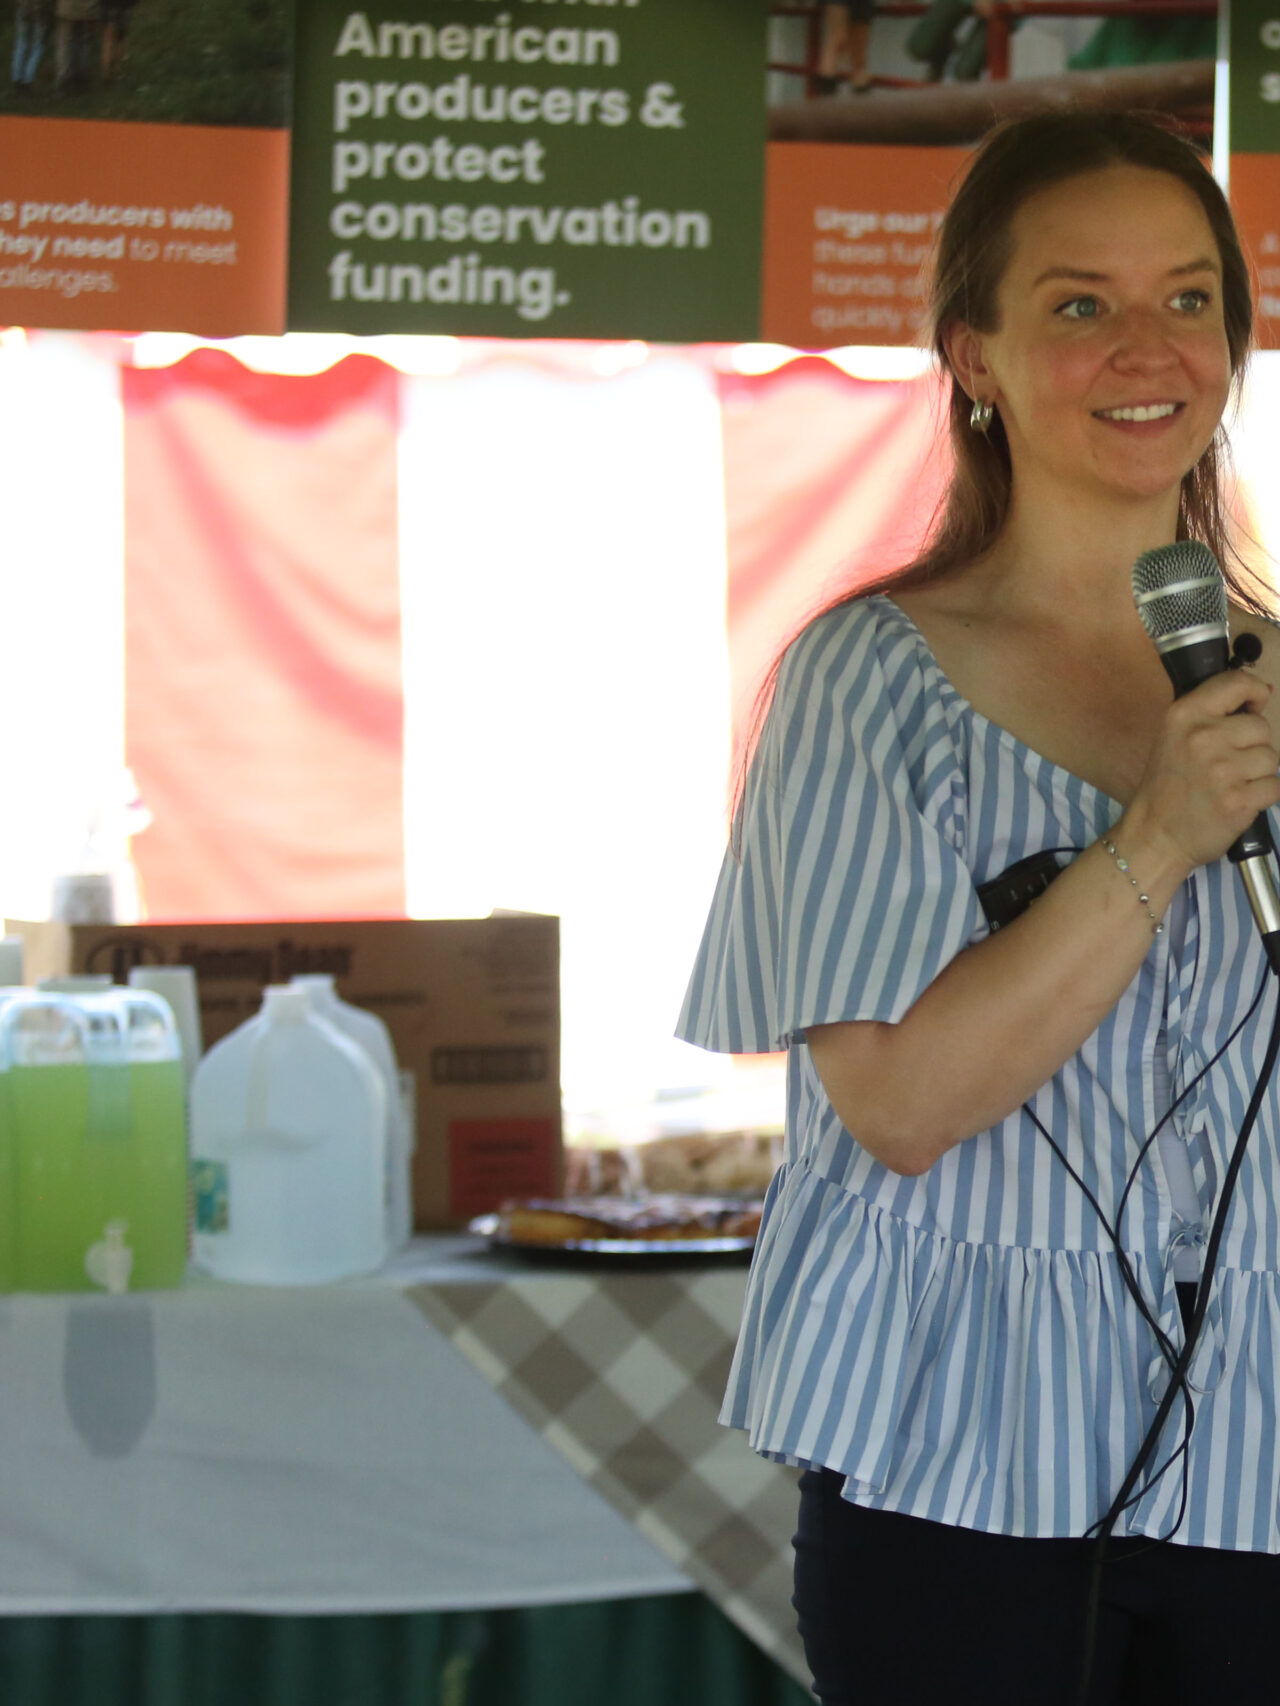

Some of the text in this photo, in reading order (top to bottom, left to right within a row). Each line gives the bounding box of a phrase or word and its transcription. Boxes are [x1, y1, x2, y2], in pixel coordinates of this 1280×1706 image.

[333, 12, 621, 67] American
[333, 75, 686, 133] producers &
[332, 136, 546, 193] protect
[19, 199, 166, 229] producers
[170, 203, 233, 230] with
[330, 196, 711, 248] conservation
[813, 207, 877, 239] Urge
[882, 212, 929, 233] our
[0, 228, 49, 263] hey
[52, 233, 125, 259] need
[129, 236, 160, 261] to
[328, 250, 572, 321] funding.
